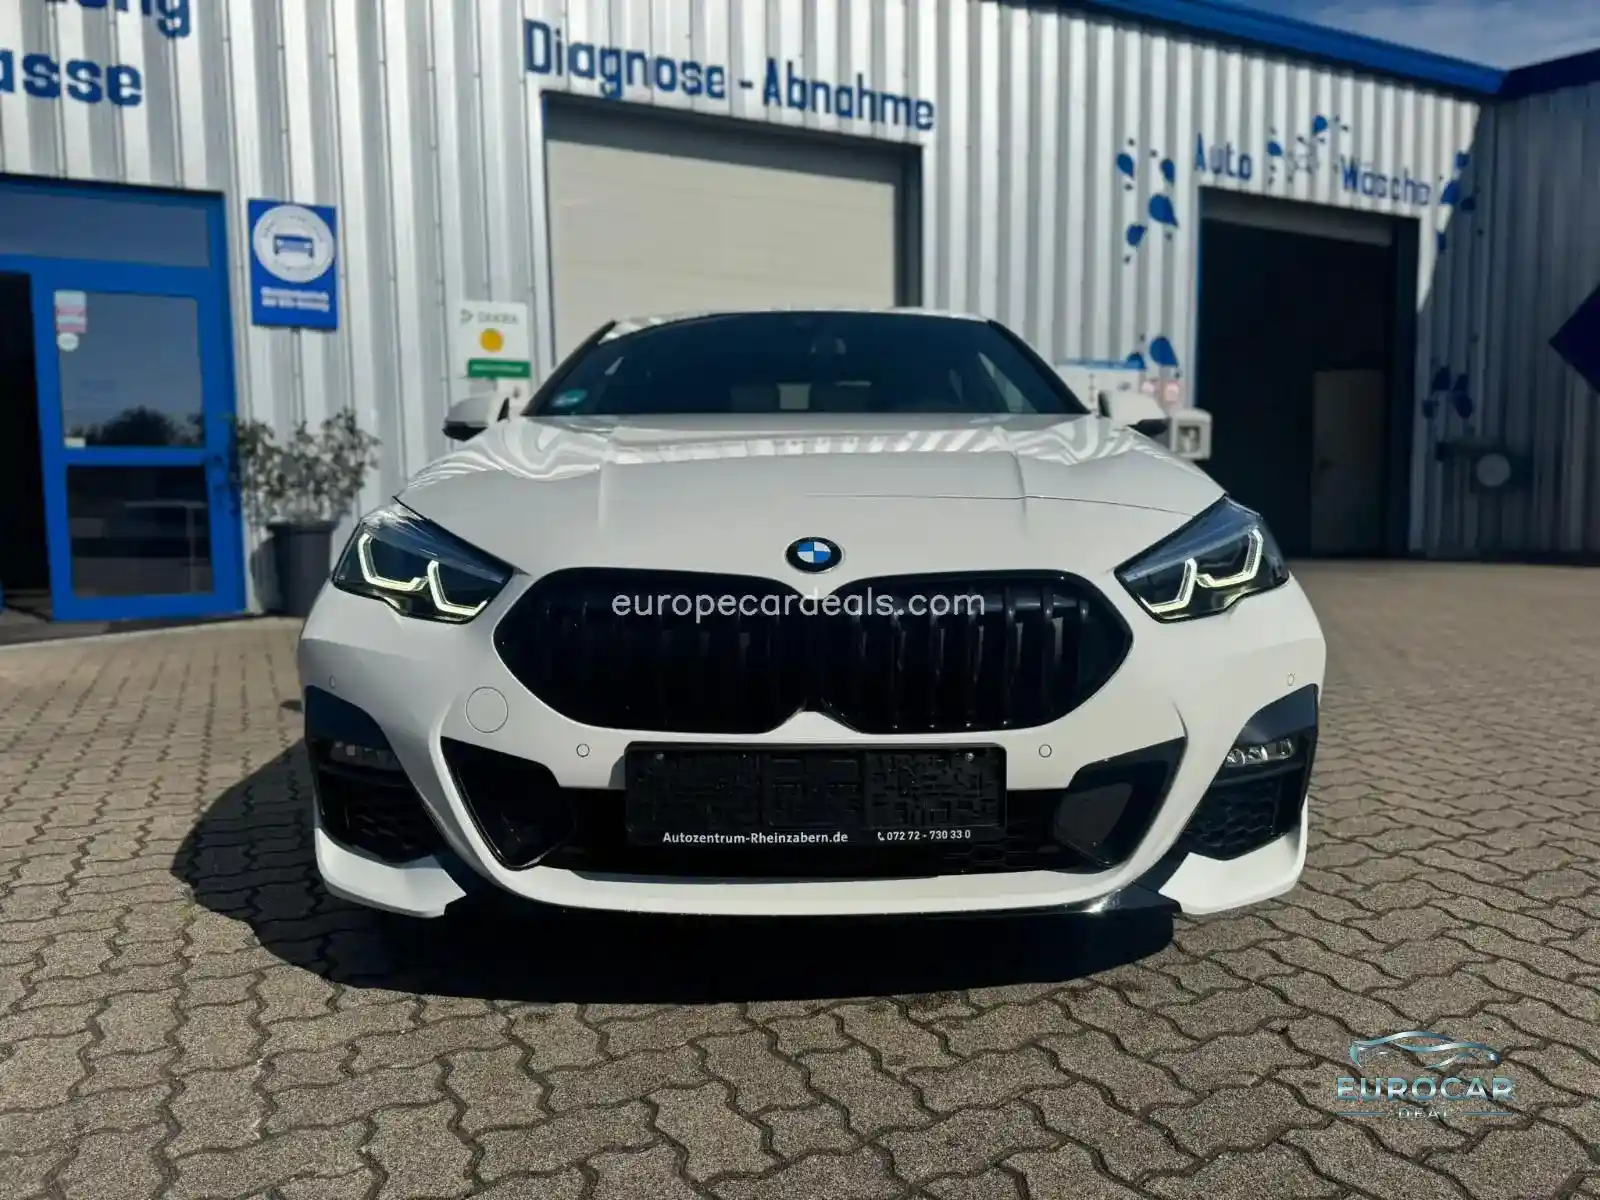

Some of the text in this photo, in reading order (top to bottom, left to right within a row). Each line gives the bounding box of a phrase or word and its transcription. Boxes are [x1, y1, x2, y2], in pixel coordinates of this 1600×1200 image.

[523, 18, 725, 99] Diagnose
[763, 57, 934, 131] Abnahme
[1194, 132, 1252, 181] Auto
[662, 830, 848, 844] Autozentrum-Rheinzabern.de
